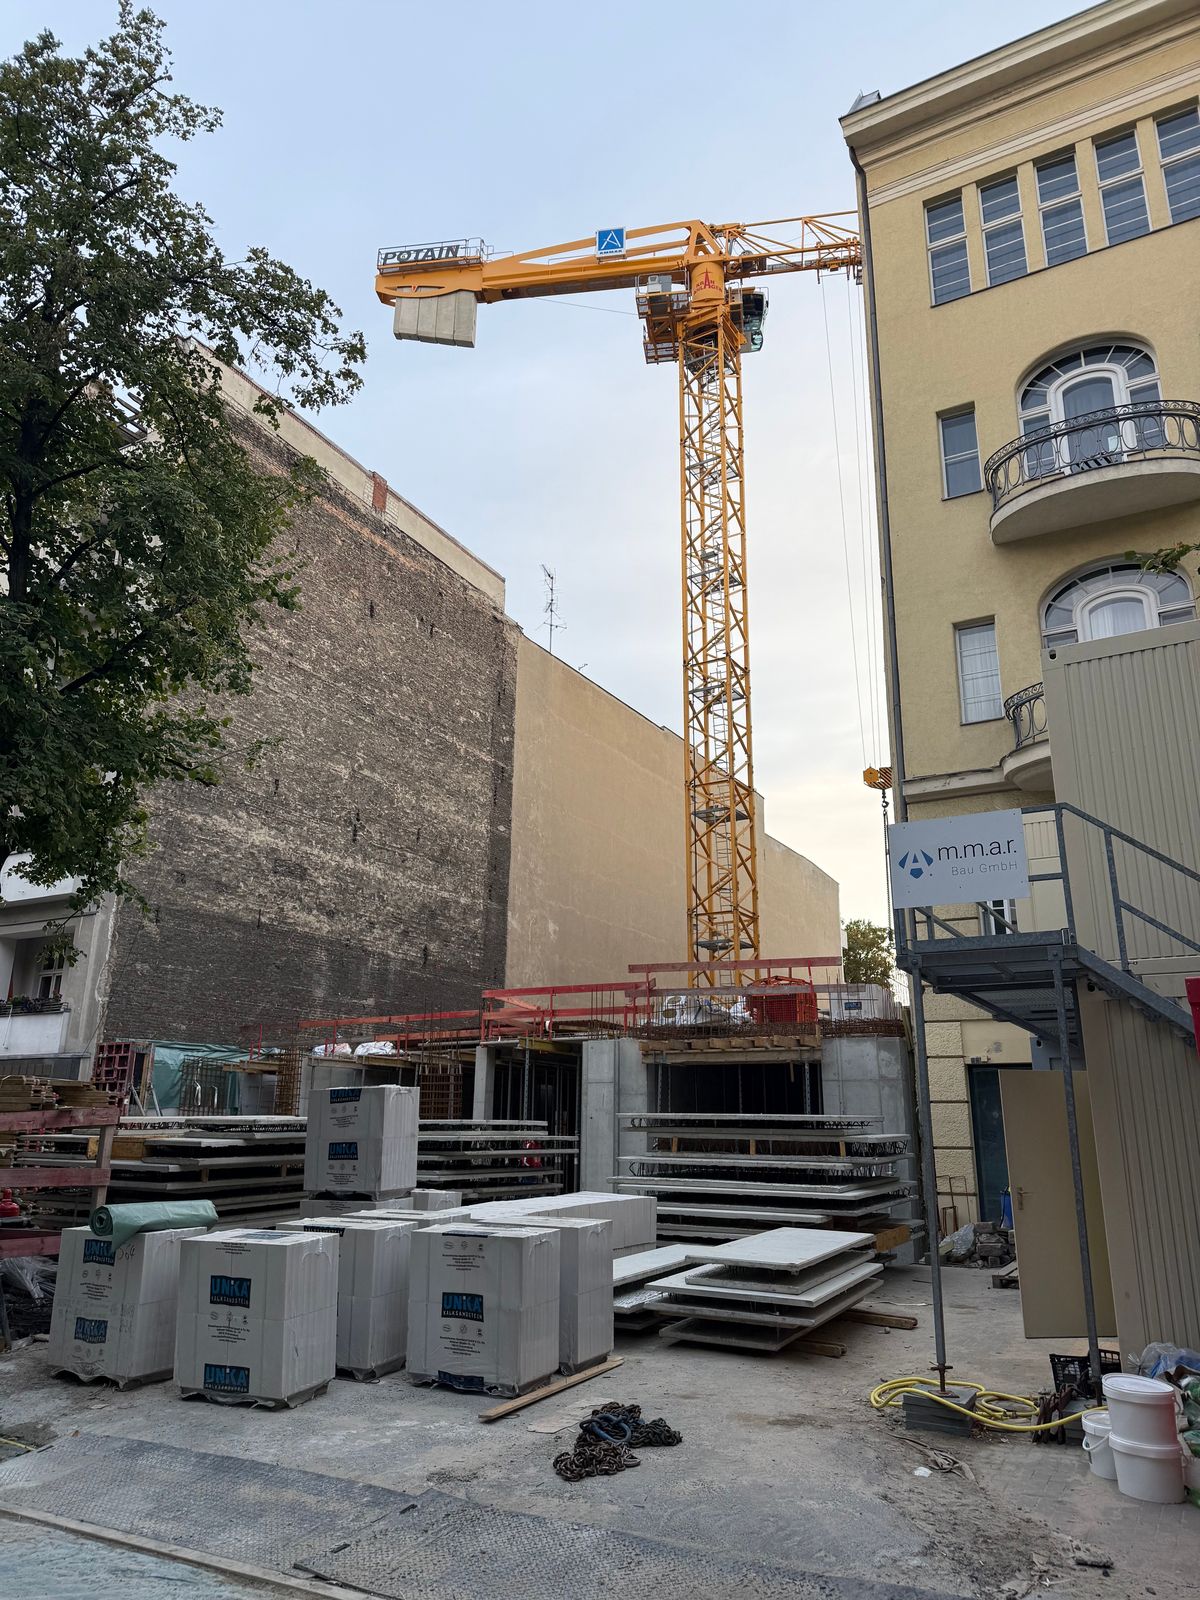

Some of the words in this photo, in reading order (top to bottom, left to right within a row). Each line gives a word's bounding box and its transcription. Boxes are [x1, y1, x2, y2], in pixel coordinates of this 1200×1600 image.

[382, 245, 460, 265] POTAIN
[951, 866, 974, 876] Bau
[979, 860, 1017, 873] GmbH
